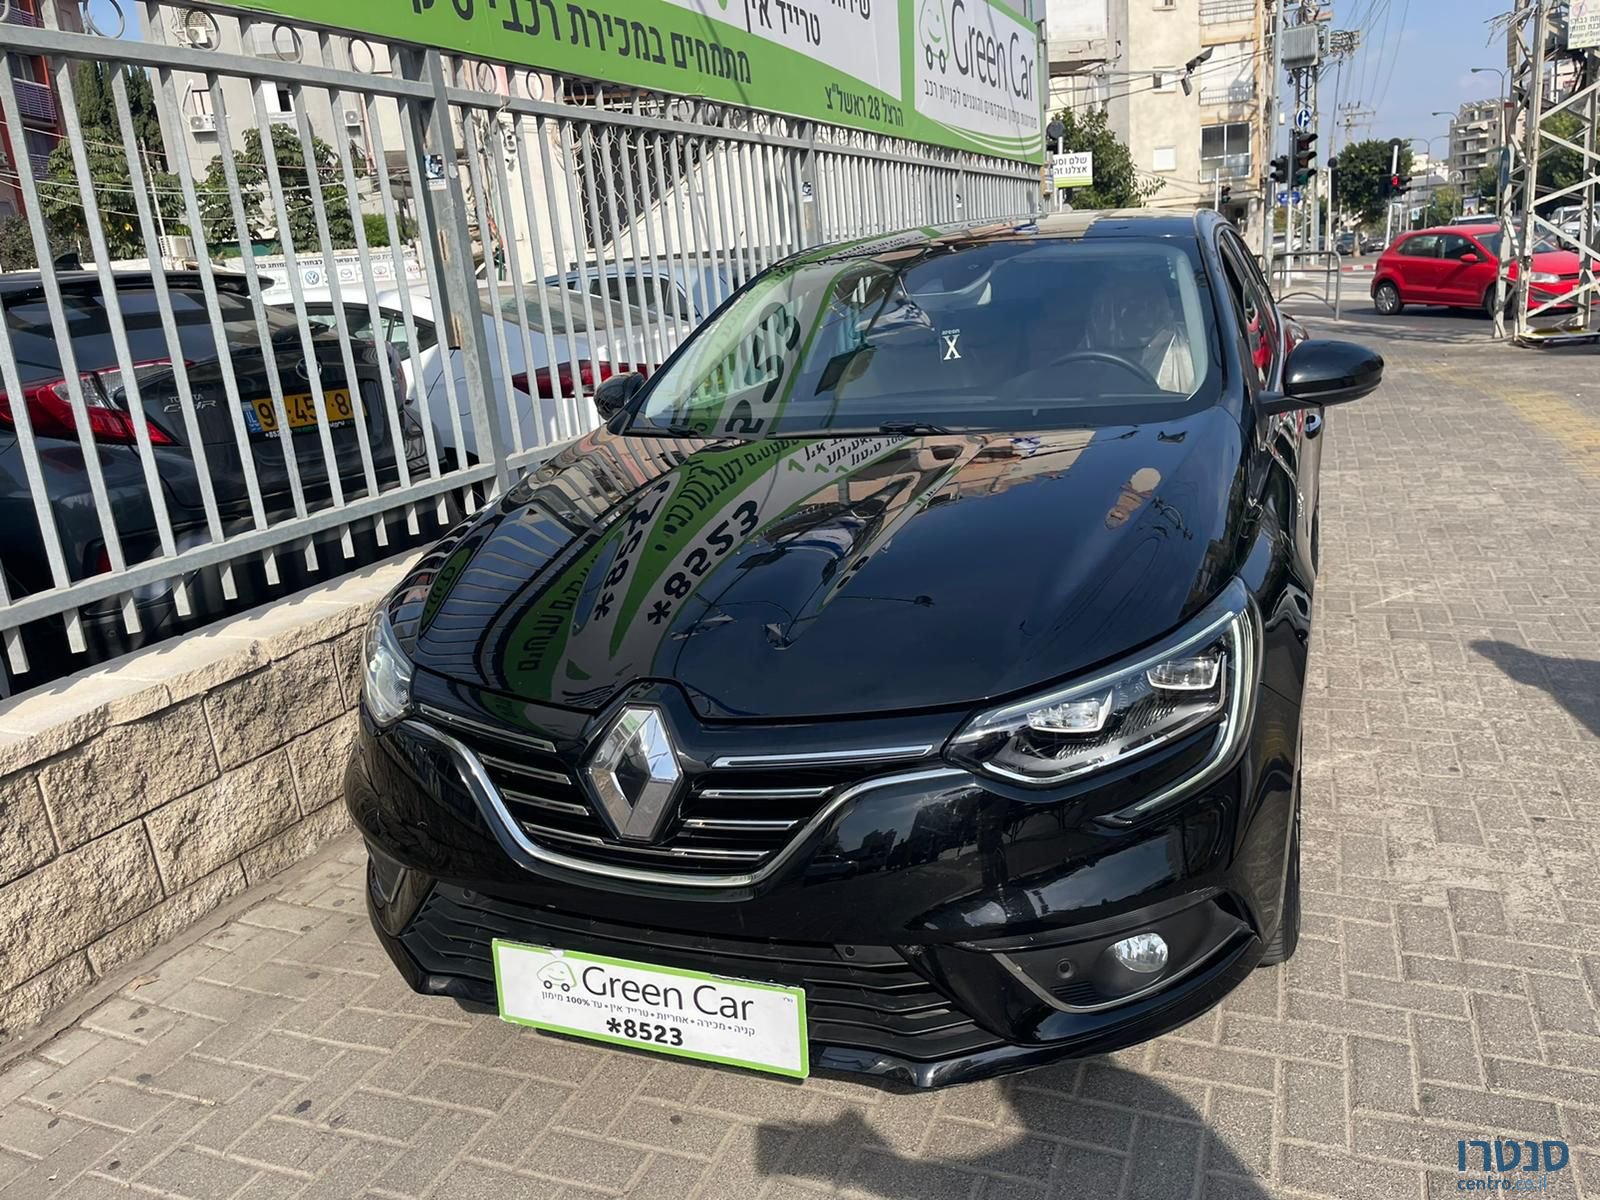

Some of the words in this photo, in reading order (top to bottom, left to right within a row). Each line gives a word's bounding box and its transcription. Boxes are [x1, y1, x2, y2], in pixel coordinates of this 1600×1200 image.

[566, 3, 667, 65] במכירת
[670, 31, 752, 84] מתמחים
[951, 0, 1008, 92] Green
[1009, 31, 1034, 102] Car
[868, 95, 881, 121] 28
[882, 97, 904, 127] הרצל
[942, 334, 962, 360] X
[541, 991, 564, 1001] מימון
[582, 965, 684, 1011] Green
[693, 984, 754, 1021] Car
[566, 995, 591, 1007] 100%
[593, 1000, 603, 1009] עד
[610, 1003, 624, 1013] אין
[626, 1006, 649, 1018] טרייד
[656, 1012, 689, 1024] אחריות
[696, 1018, 726, 1030] מכירה
[734, 1024, 756, 1037] קניה
